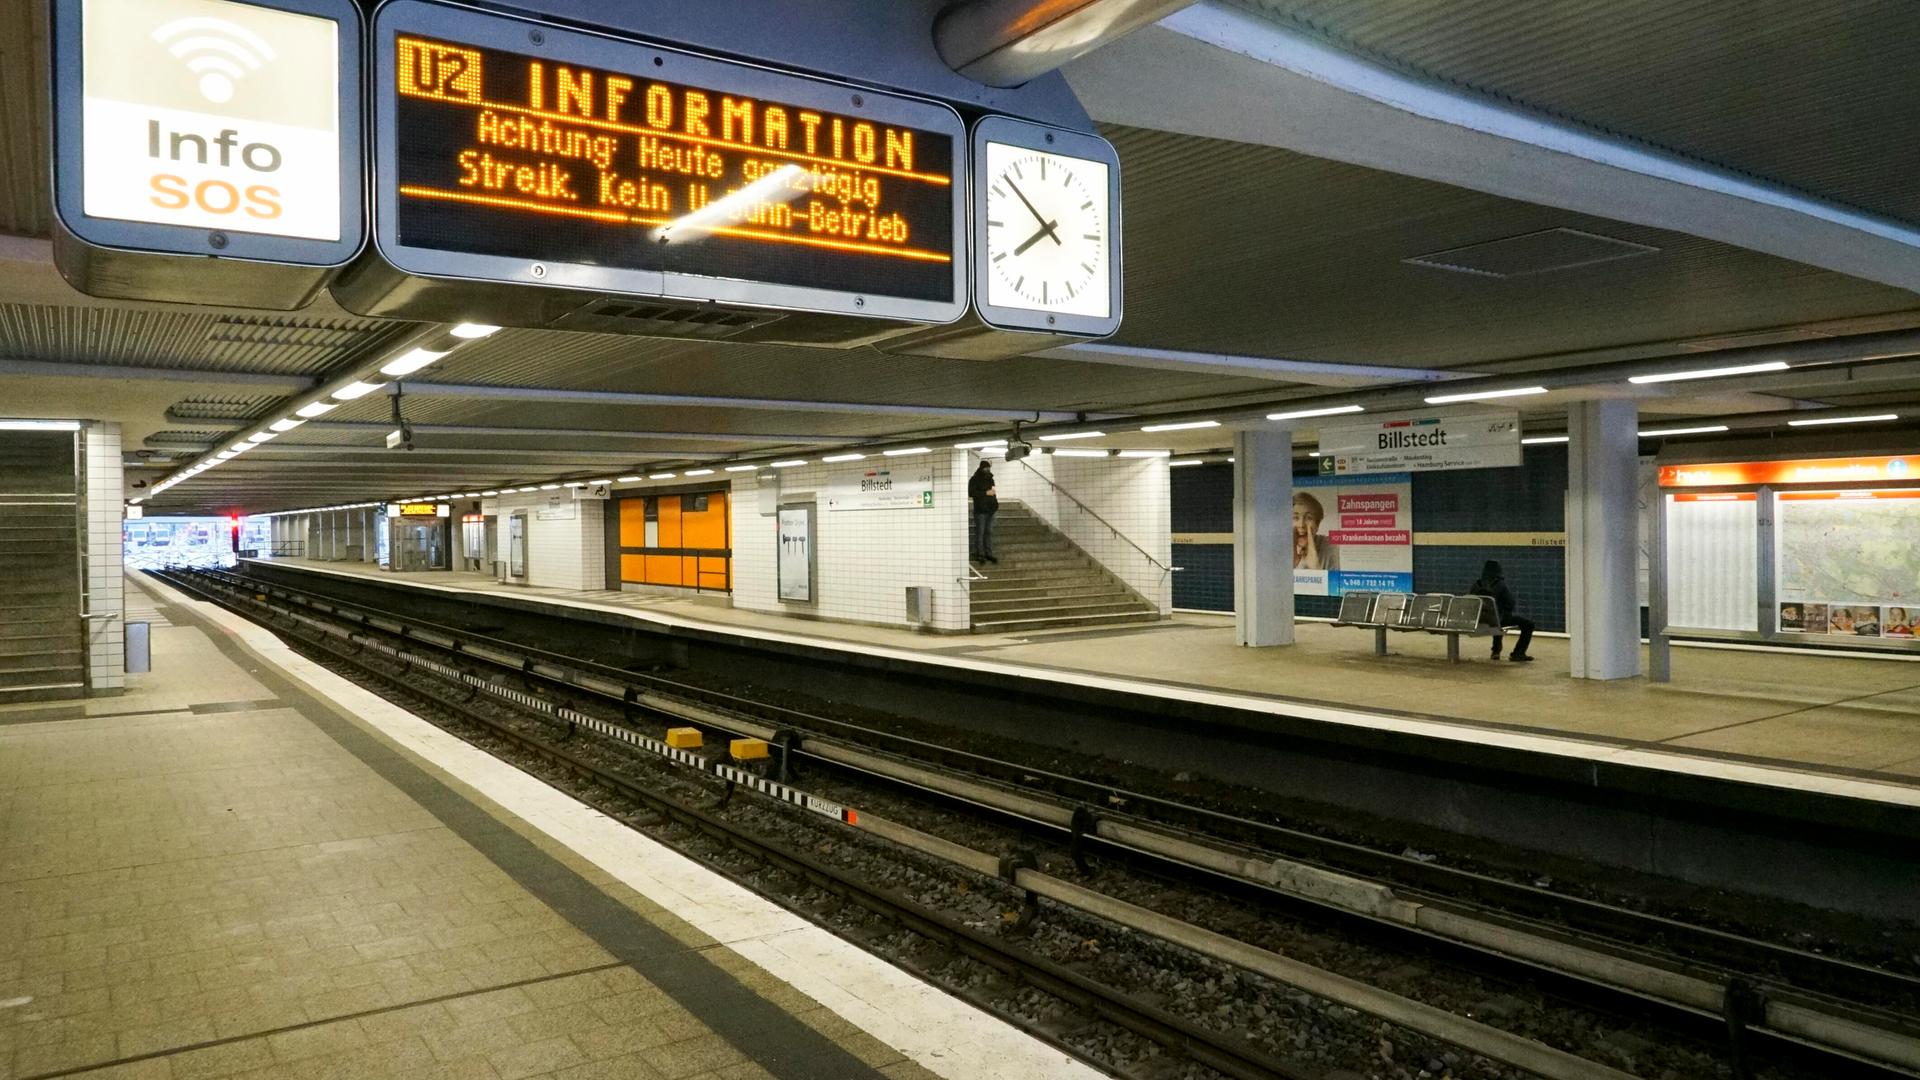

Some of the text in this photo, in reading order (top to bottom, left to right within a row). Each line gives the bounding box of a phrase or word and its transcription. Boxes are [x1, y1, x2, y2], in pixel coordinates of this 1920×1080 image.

[406, 43, 913, 170] U2 INFORMATION
[148, 119, 282, 172] Info
[479, 110, 617, 169] Achtung:
[639, 136, 723, 178] Heute
[149, 173, 283, 220] SOS
[459, 150, 908, 243] Streik. Kein Uahn-Betrieb
[1378, 429, 1447, 449] Billstedt
[861, 477, 892, 492] Billstedt
[1341, 498, 1395, 511] Zahnspangen
[1342, 532, 1384, 542] Krankenkassen
[1385, 532, 1407, 542] bezahlt
[1295, 575, 1323, 584] AHNSPANGE
